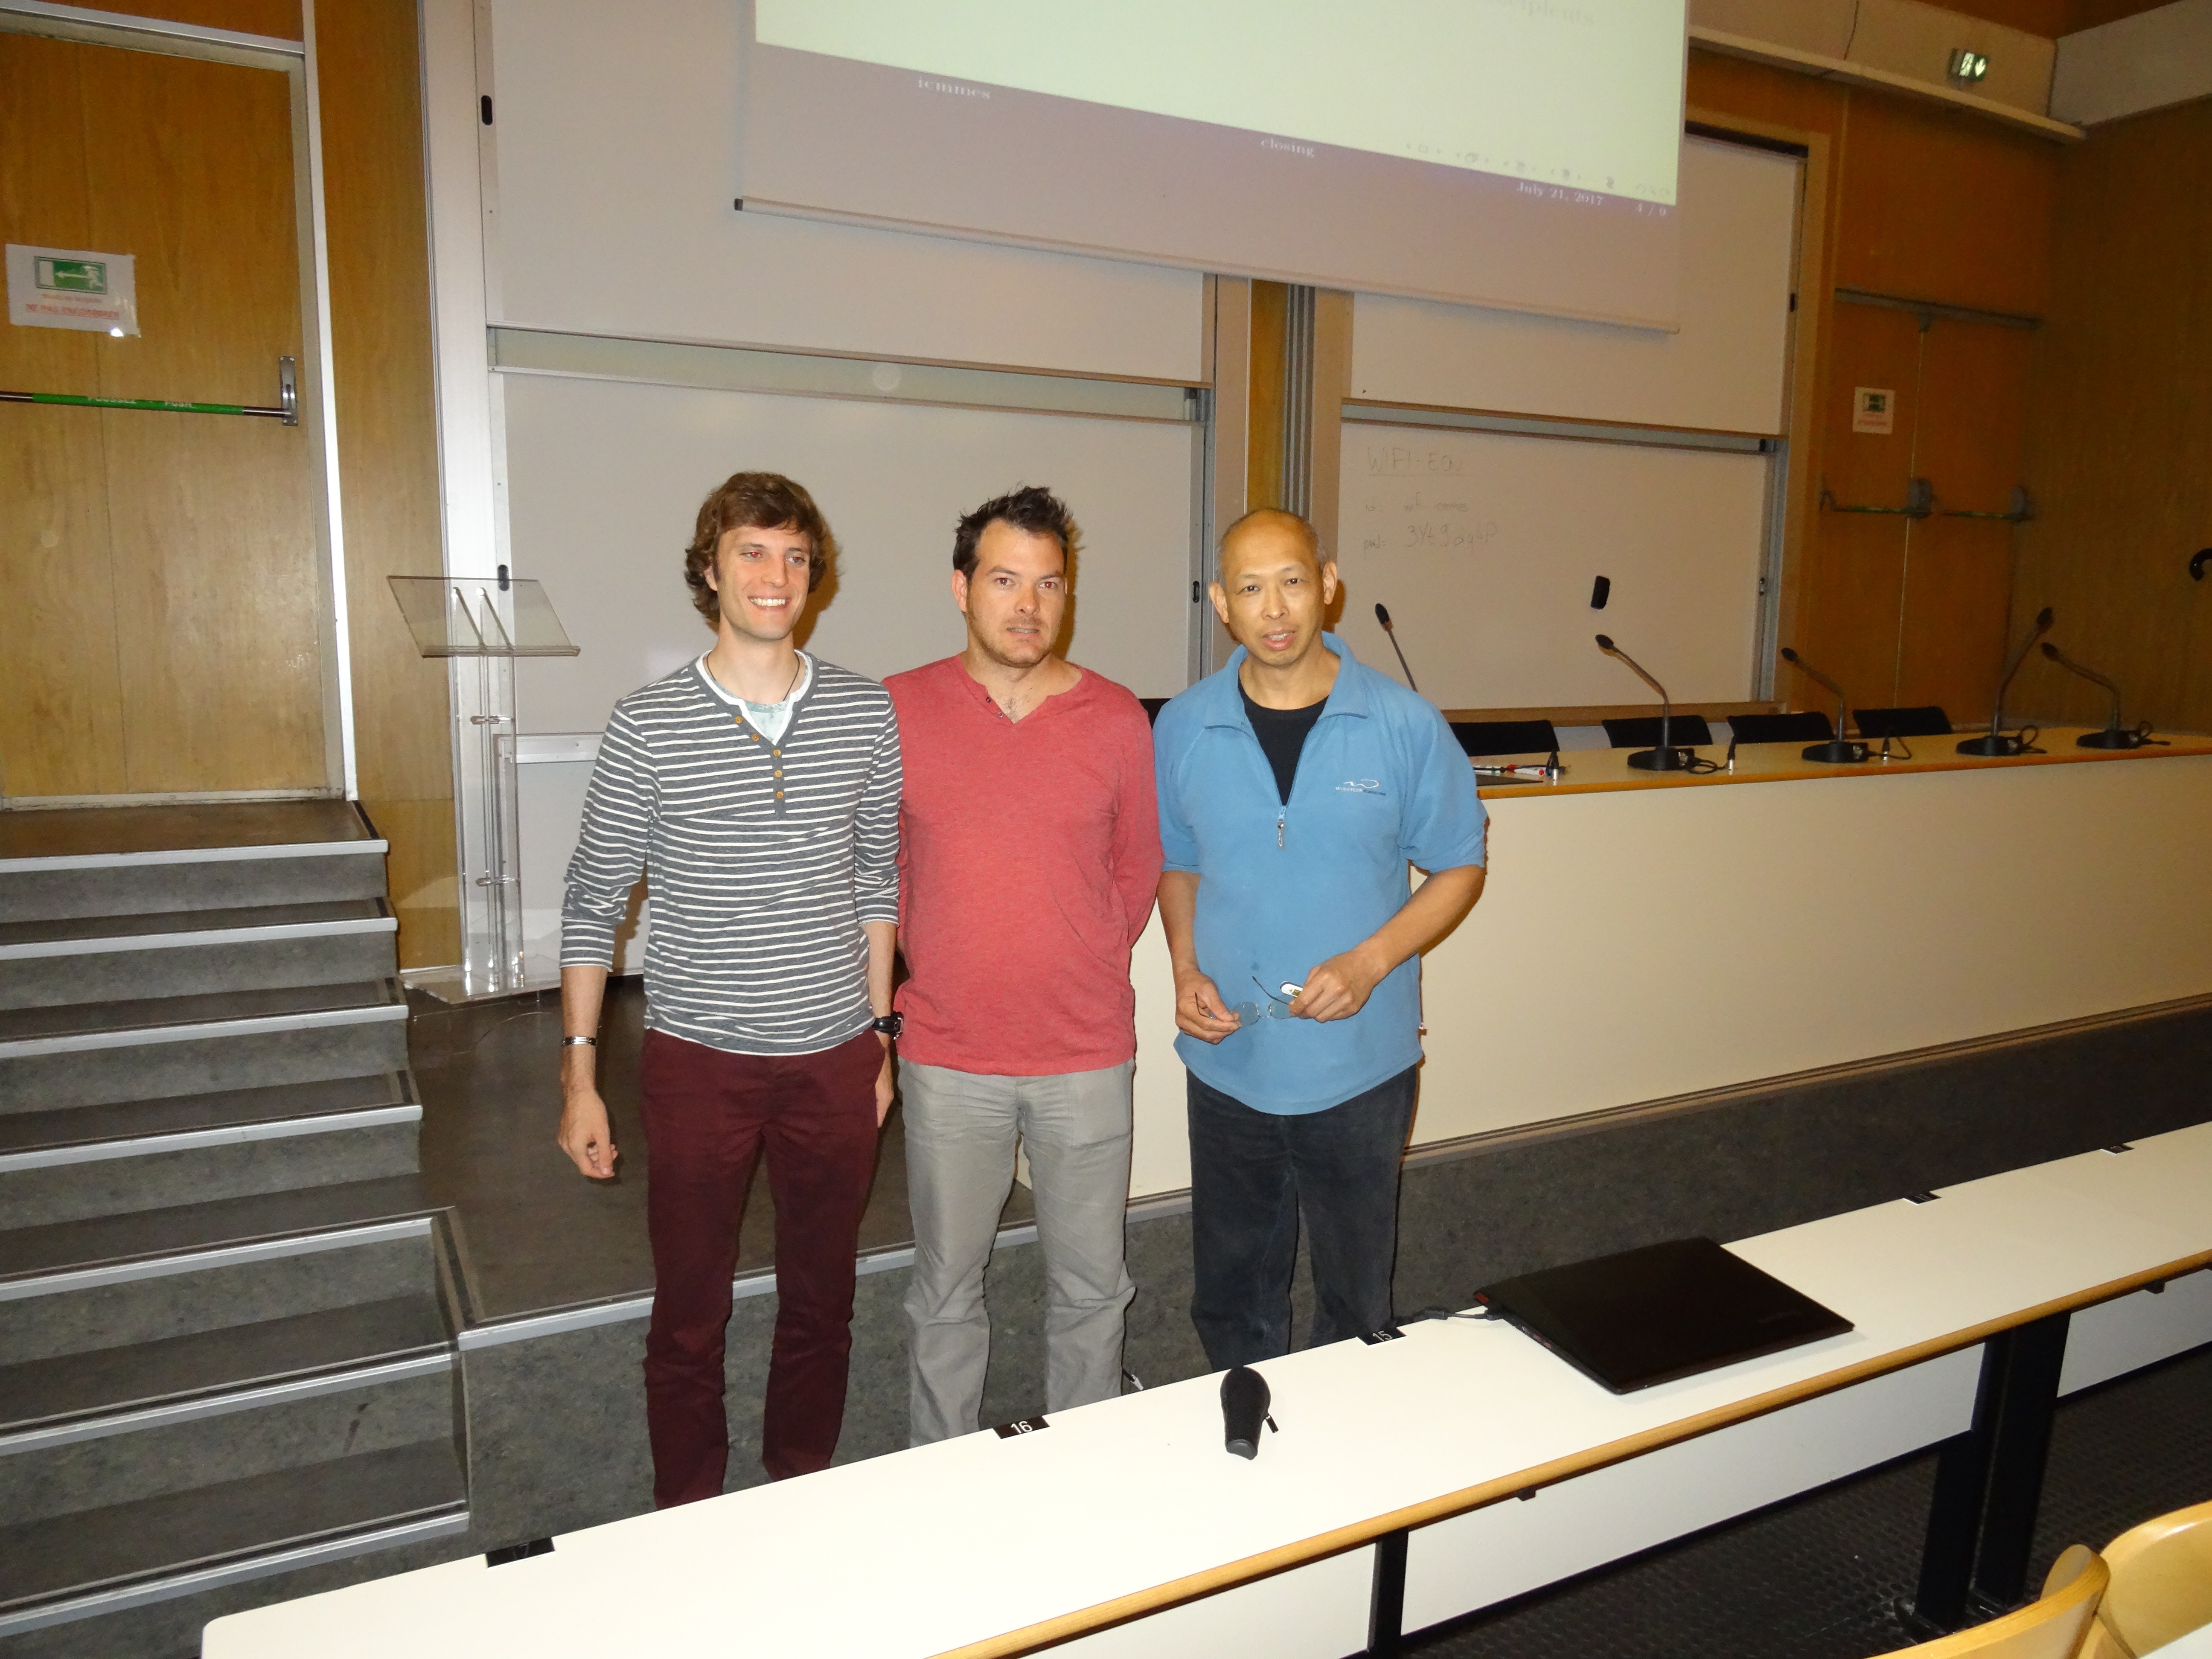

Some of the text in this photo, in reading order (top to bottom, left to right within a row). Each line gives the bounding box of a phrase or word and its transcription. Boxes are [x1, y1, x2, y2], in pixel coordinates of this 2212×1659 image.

[1261, 137, 1316, 158] closing
[1517, 182, 1544, 197] July
[1574, 191, 1604, 206] 2017
[1372, 1330, 1393, 1342] 15
[1010, 1420, 1033, 1434] 16
